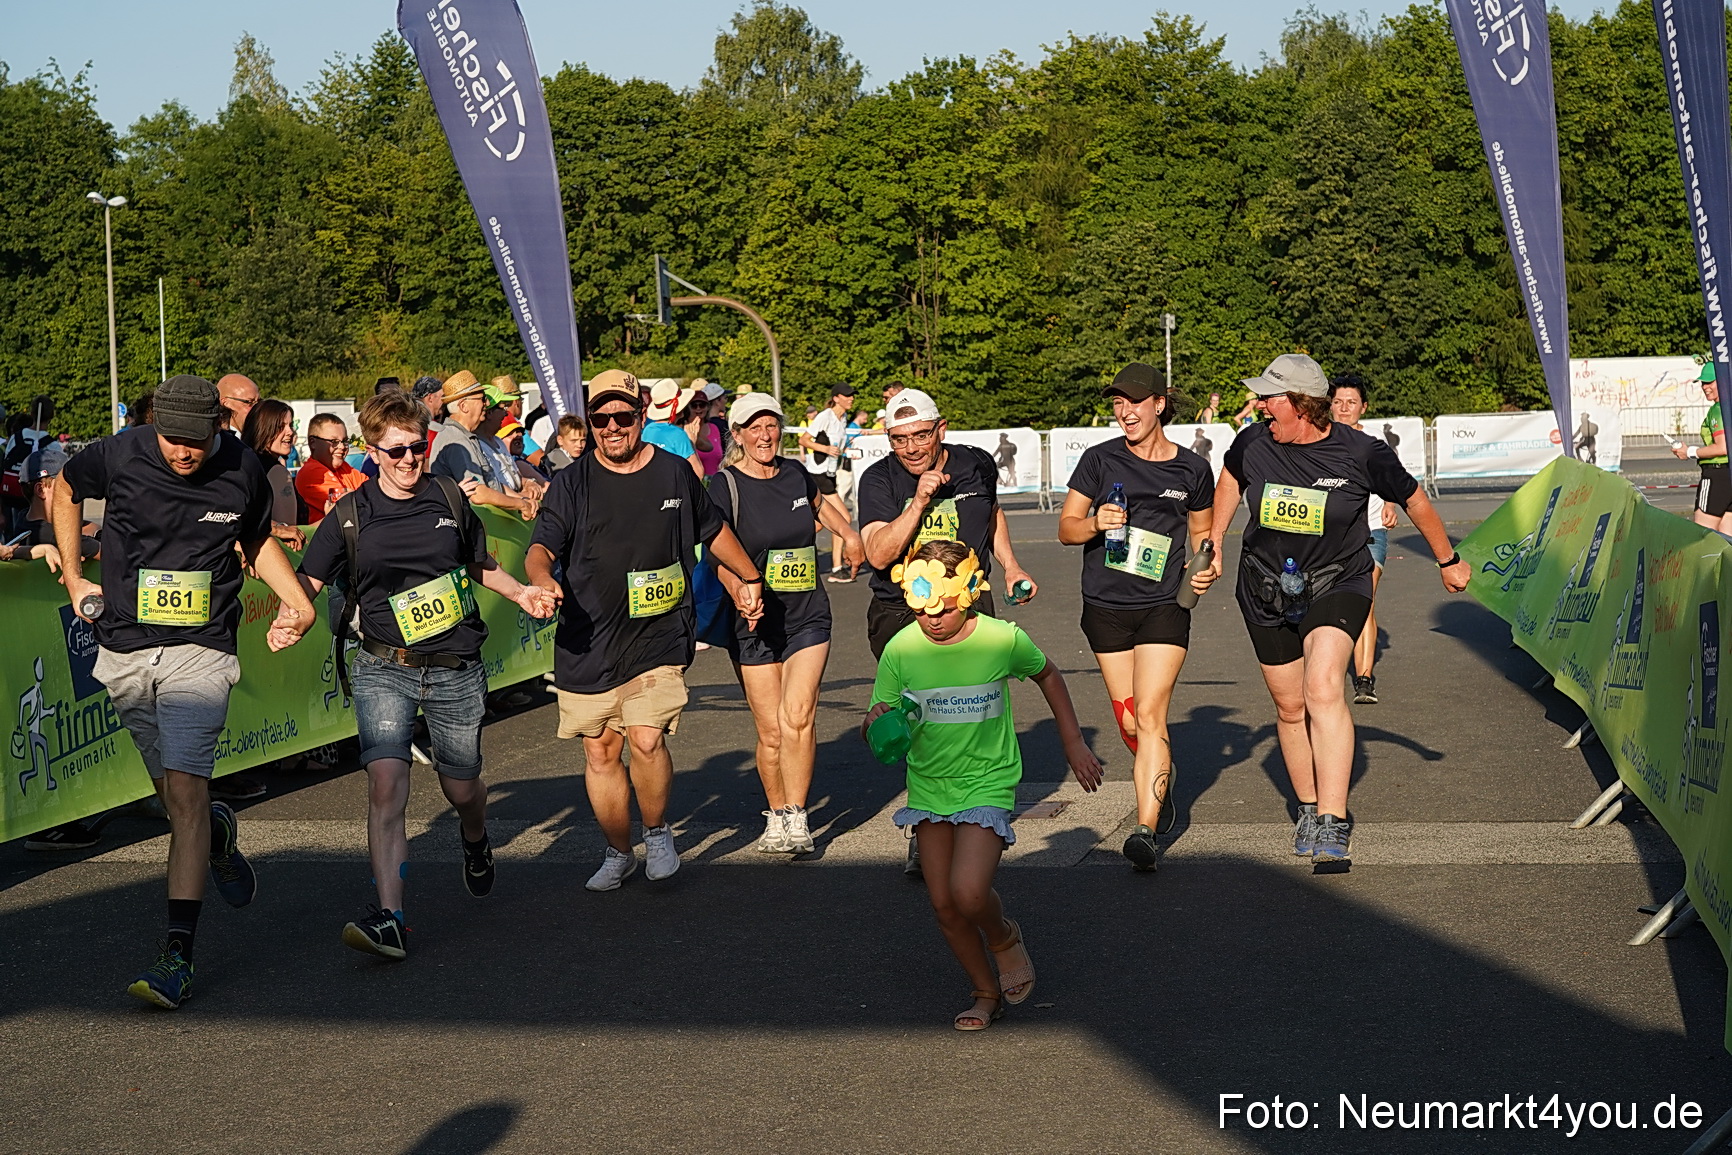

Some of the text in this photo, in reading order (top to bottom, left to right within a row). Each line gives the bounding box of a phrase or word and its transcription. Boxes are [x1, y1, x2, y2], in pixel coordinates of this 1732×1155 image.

[1263, 501, 1271, 522] WALK
[1276, 501, 1308, 519] 869
[923, 514, 944, 529] 04
[1292, 518, 1311, 527] Gisela
[781, 563, 807, 578] 862
[1154, 554, 1165, 574] 2022
[157, 590, 192, 608] 861
[645, 582, 673, 601] 860
[244, 592, 282, 627] länge
[411, 598, 445, 623] 880
[449, 594, 460, 616] 2022
[400, 614, 412, 638] WALK
[428, 613, 452, 626] Claudia
[76, 630, 95, 649] Fisc
[926, 690, 1001, 706] Freie Grundschule
[938, 707, 957, 715] Haus
[968, 703, 992, 714] Marien
[55, 695, 119, 756] firme
[214, 712, 298, 760] auf-oberpfalz.de
[62, 737, 117, 781] neumarkt
